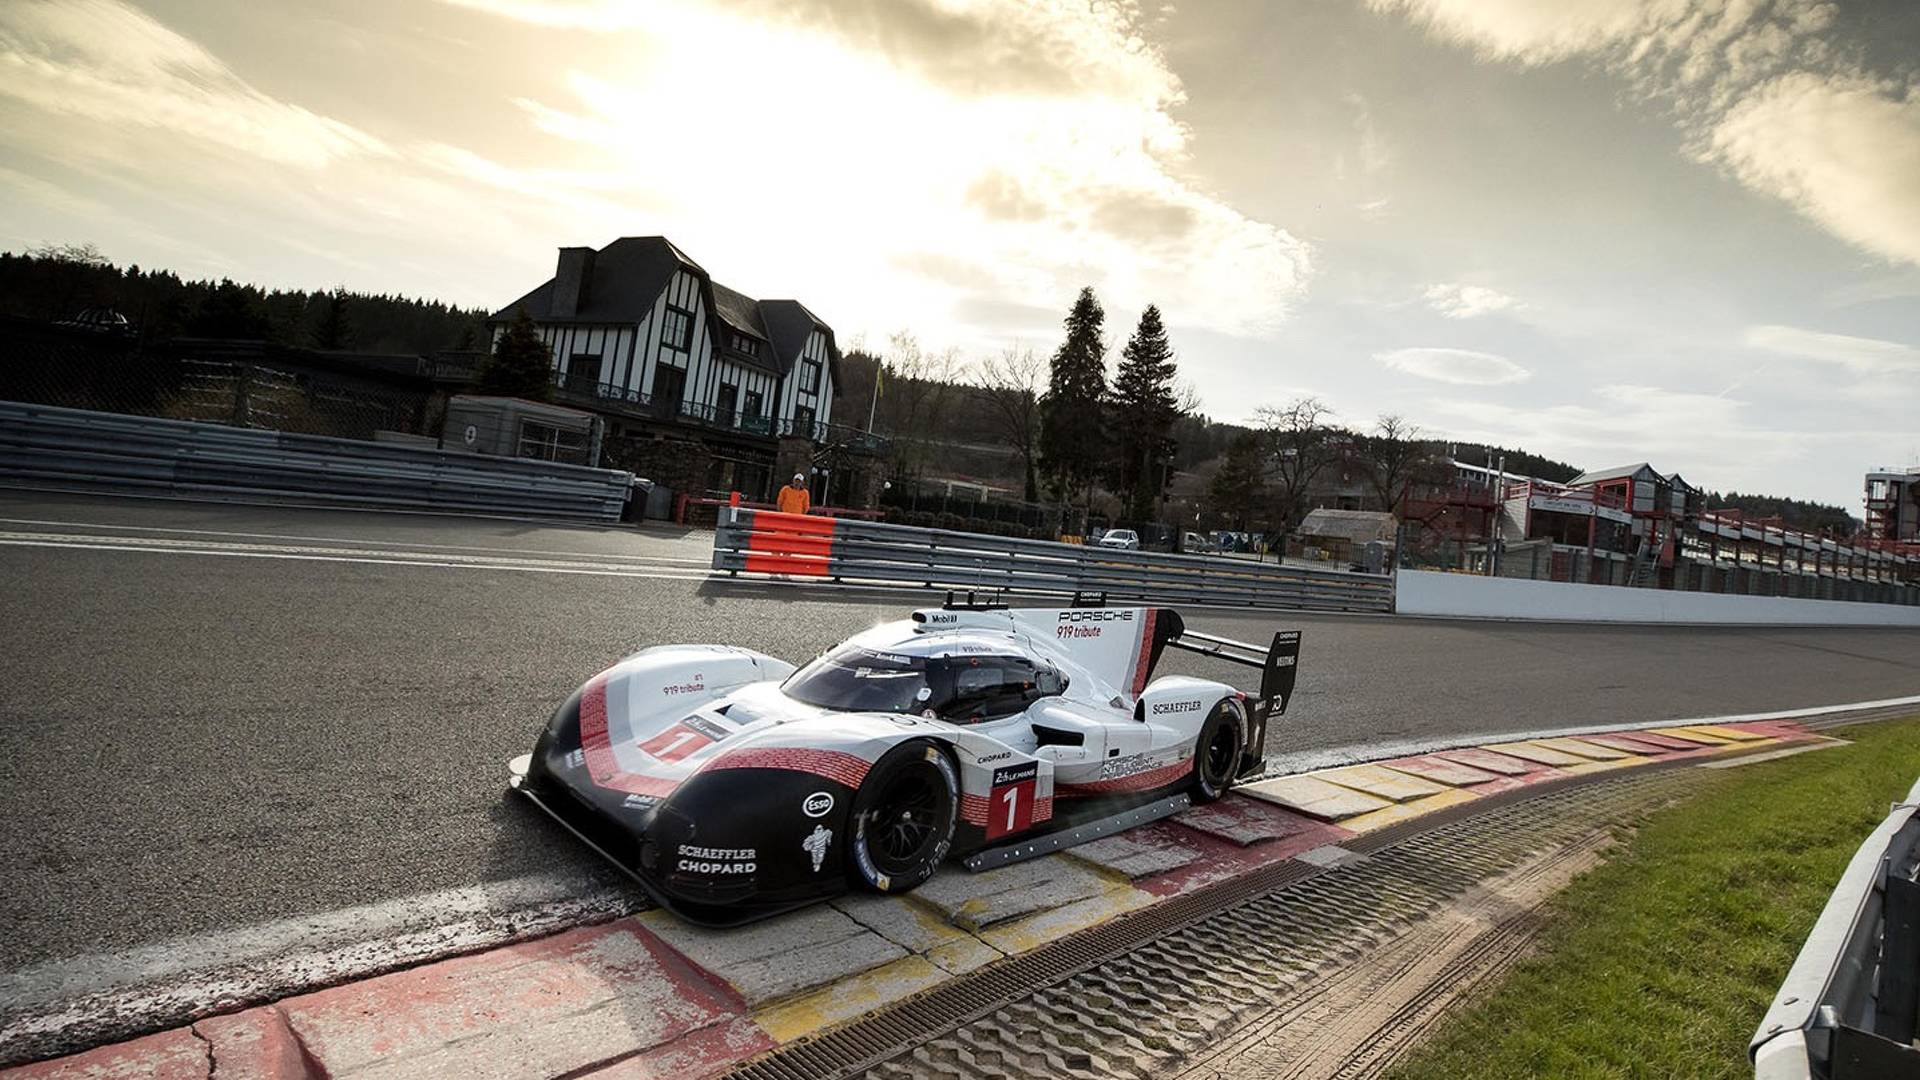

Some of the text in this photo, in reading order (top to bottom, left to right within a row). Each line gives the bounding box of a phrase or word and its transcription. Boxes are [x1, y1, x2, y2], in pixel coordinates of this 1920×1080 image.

[1058, 611, 1133, 623] PORSCHE
[1056, 625, 1101, 639] 919 tribute
[663, 685, 679, 696] 919
[1152, 701, 1202, 715] SCHAEFFLER
[652, 731, 697, 757] 1
[977, 751, 1012, 765] CHOPARD
[808, 798, 830, 811] Esso
[1003, 786, 1018, 832] 1
[678, 844, 756, 860] SCHAEFFLER
[678, 860, 757, 874] CHOPARD
